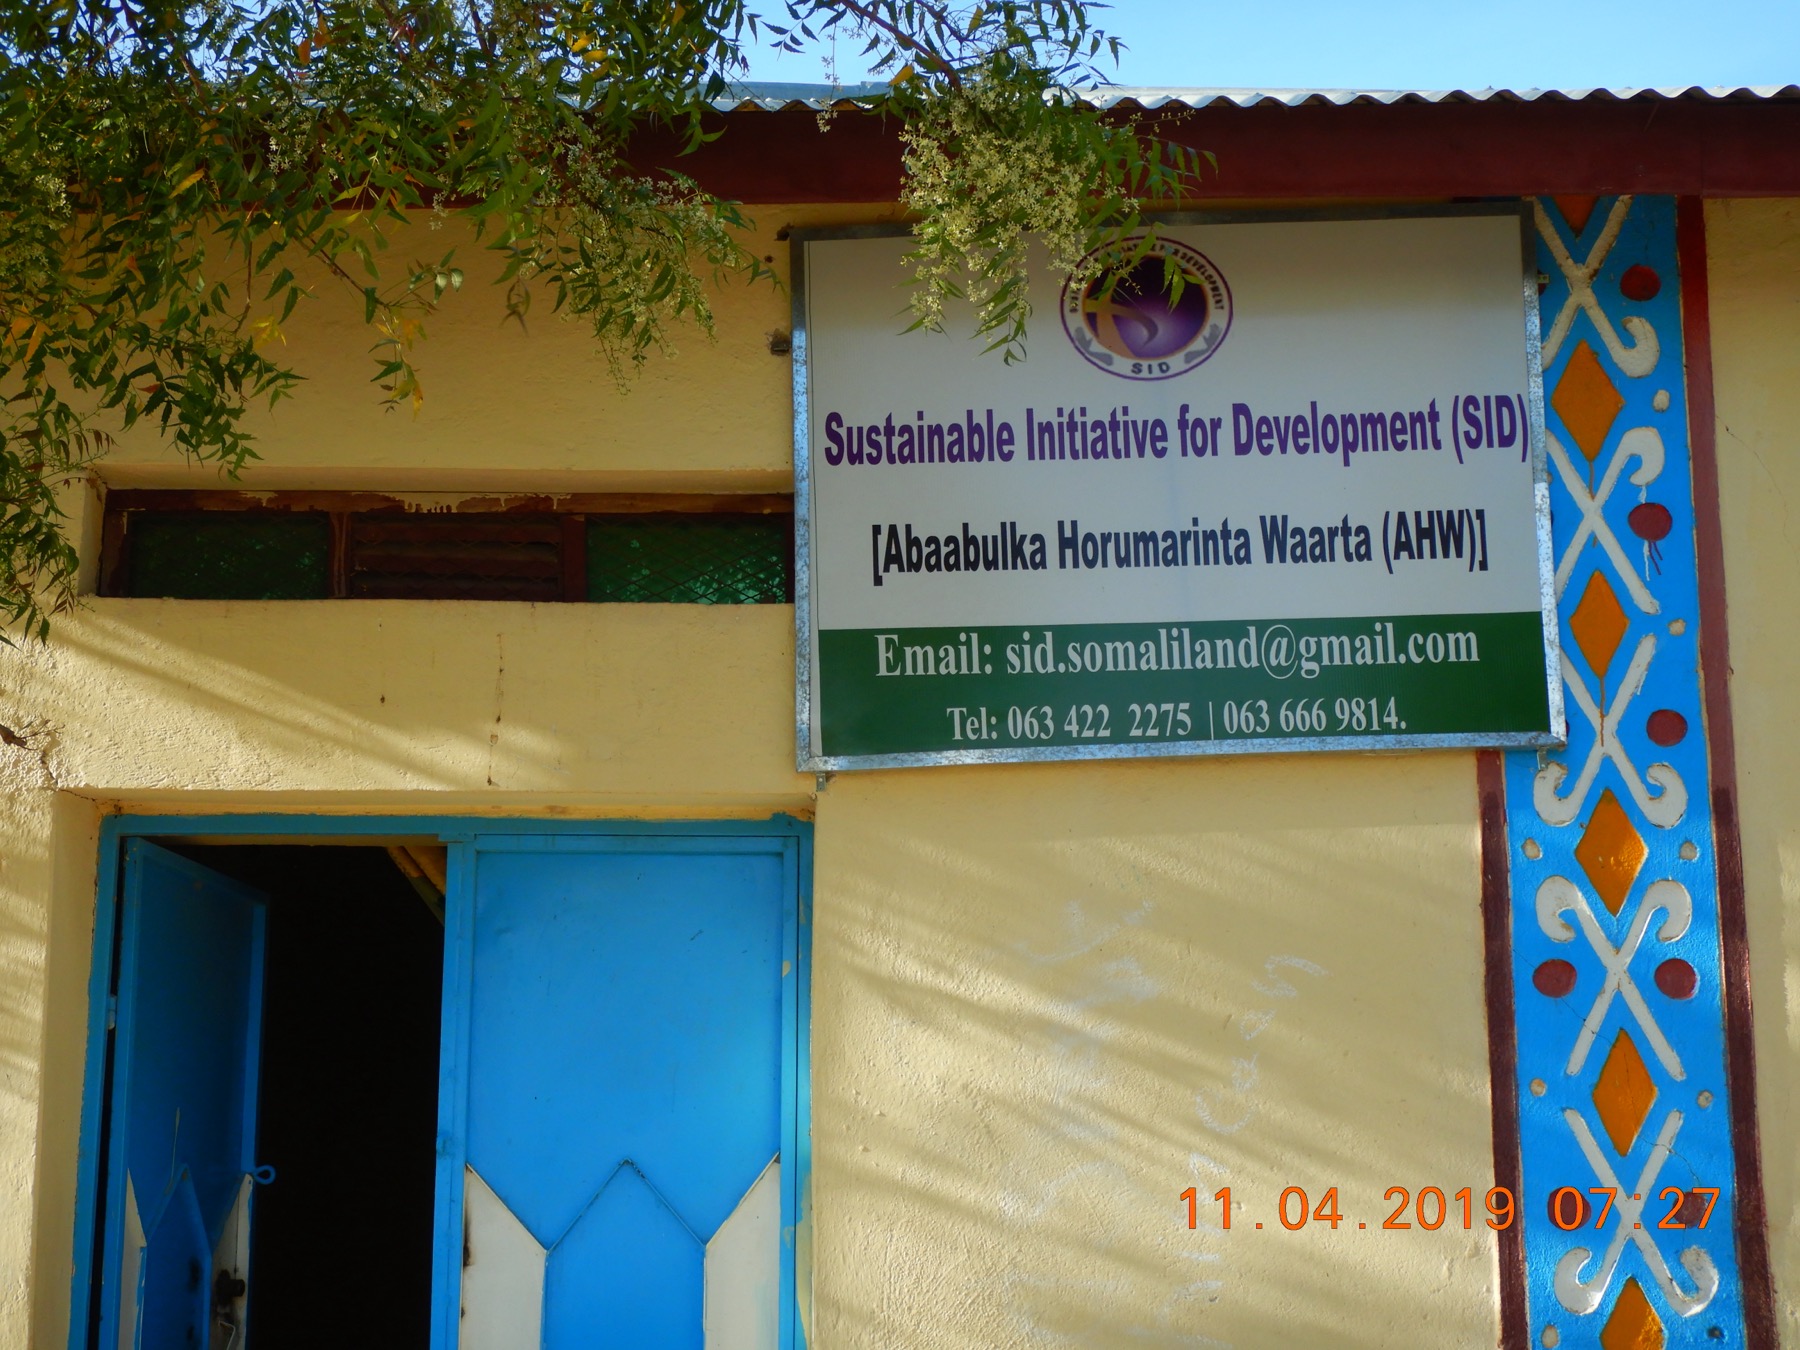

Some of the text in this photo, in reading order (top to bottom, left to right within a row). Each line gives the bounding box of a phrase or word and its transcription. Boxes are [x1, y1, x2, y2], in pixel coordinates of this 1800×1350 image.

[1130, 361, 1172, 375] SID
[823, 393, 1529, 467] Sustainable Initiative for Development (SID)
[871, 508, 1489, 587] [Abaabulka Horumarinta Waarta (AHW)]
[873, 622, 1480, 680] Email: sid.somaliland@gmail.com
[946, 707, 998, 741] Tel:
[1007, 705, 1055, 740] 063
[1063, 704, 1111, 738] 422
[1128, 702, 1192, 738] 2275
[1222, 699, 1271, 735] 063
[1279, 698, 1327, 733] 666
[1334, 696, 1407, 732] 9814.
